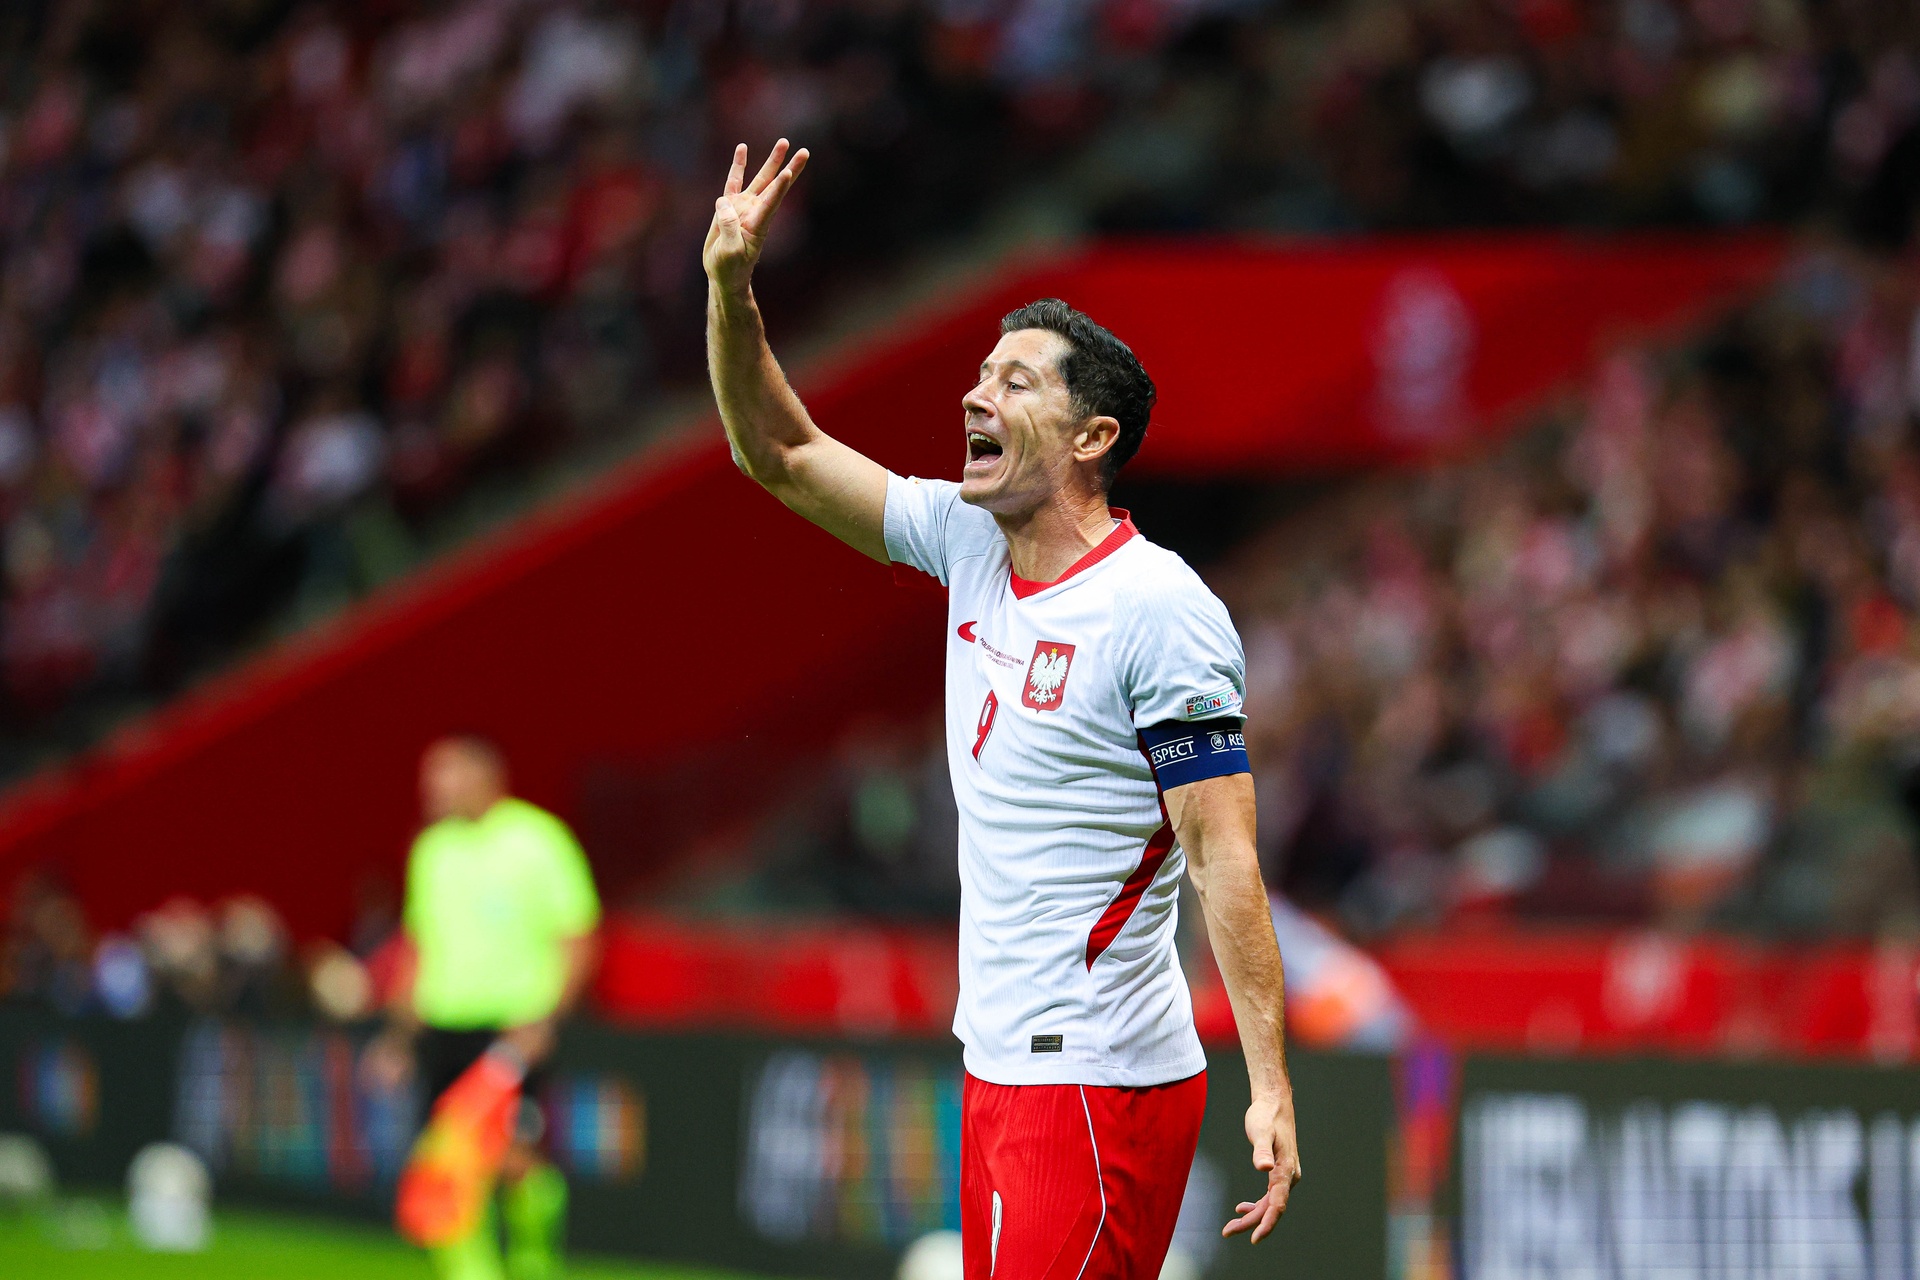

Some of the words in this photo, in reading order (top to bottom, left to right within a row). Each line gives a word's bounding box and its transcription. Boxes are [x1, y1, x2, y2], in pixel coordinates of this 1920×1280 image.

[1186, 695, 1204, 704] UEFA
[972, 689, 998, 766] 9
[1151, 741, 1194, 764] ESPECT
